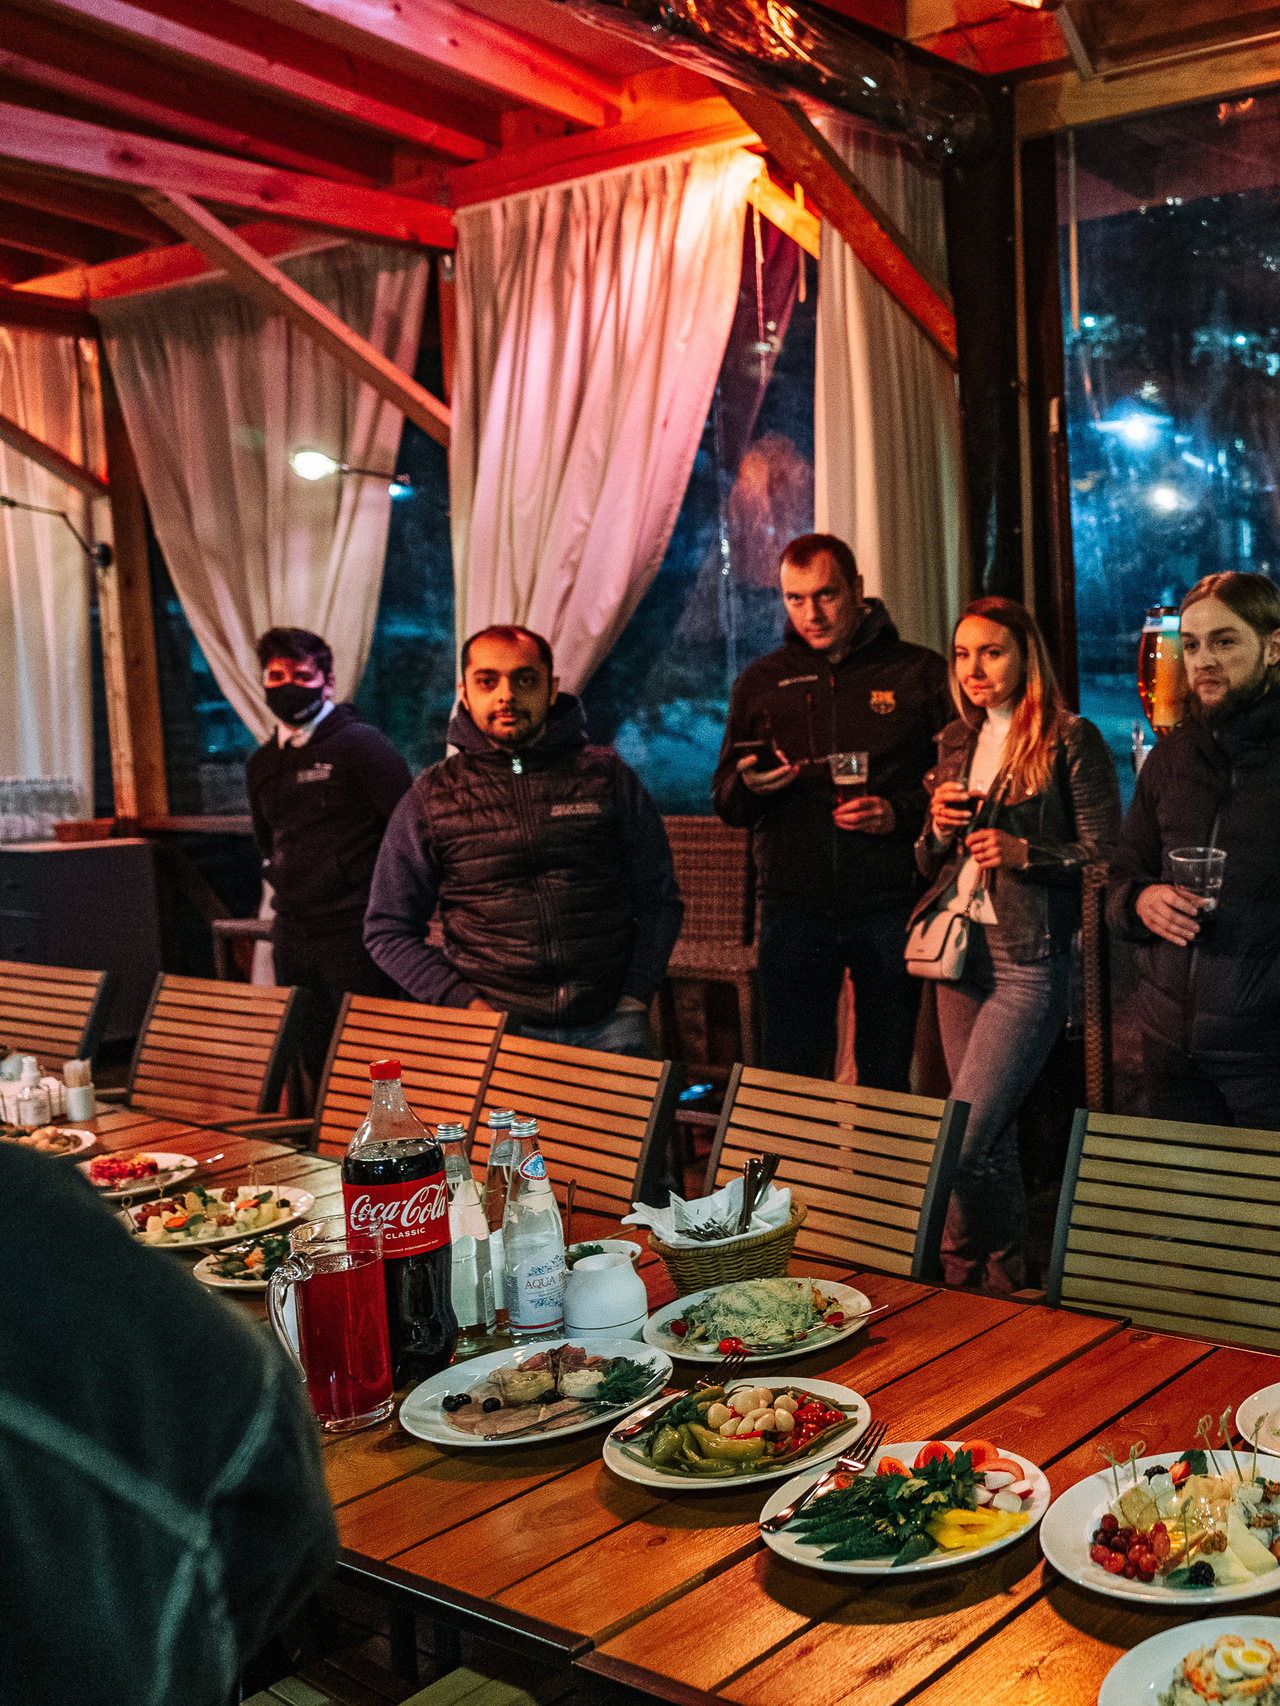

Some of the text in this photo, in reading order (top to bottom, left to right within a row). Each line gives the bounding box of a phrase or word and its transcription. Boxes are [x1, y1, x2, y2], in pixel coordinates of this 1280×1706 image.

[350, 1180, 446, 1231] Coca-Cola
[385, 1227, 426, 1240] CLASSIC
[525, 1276, 556, 1289] AQUA
